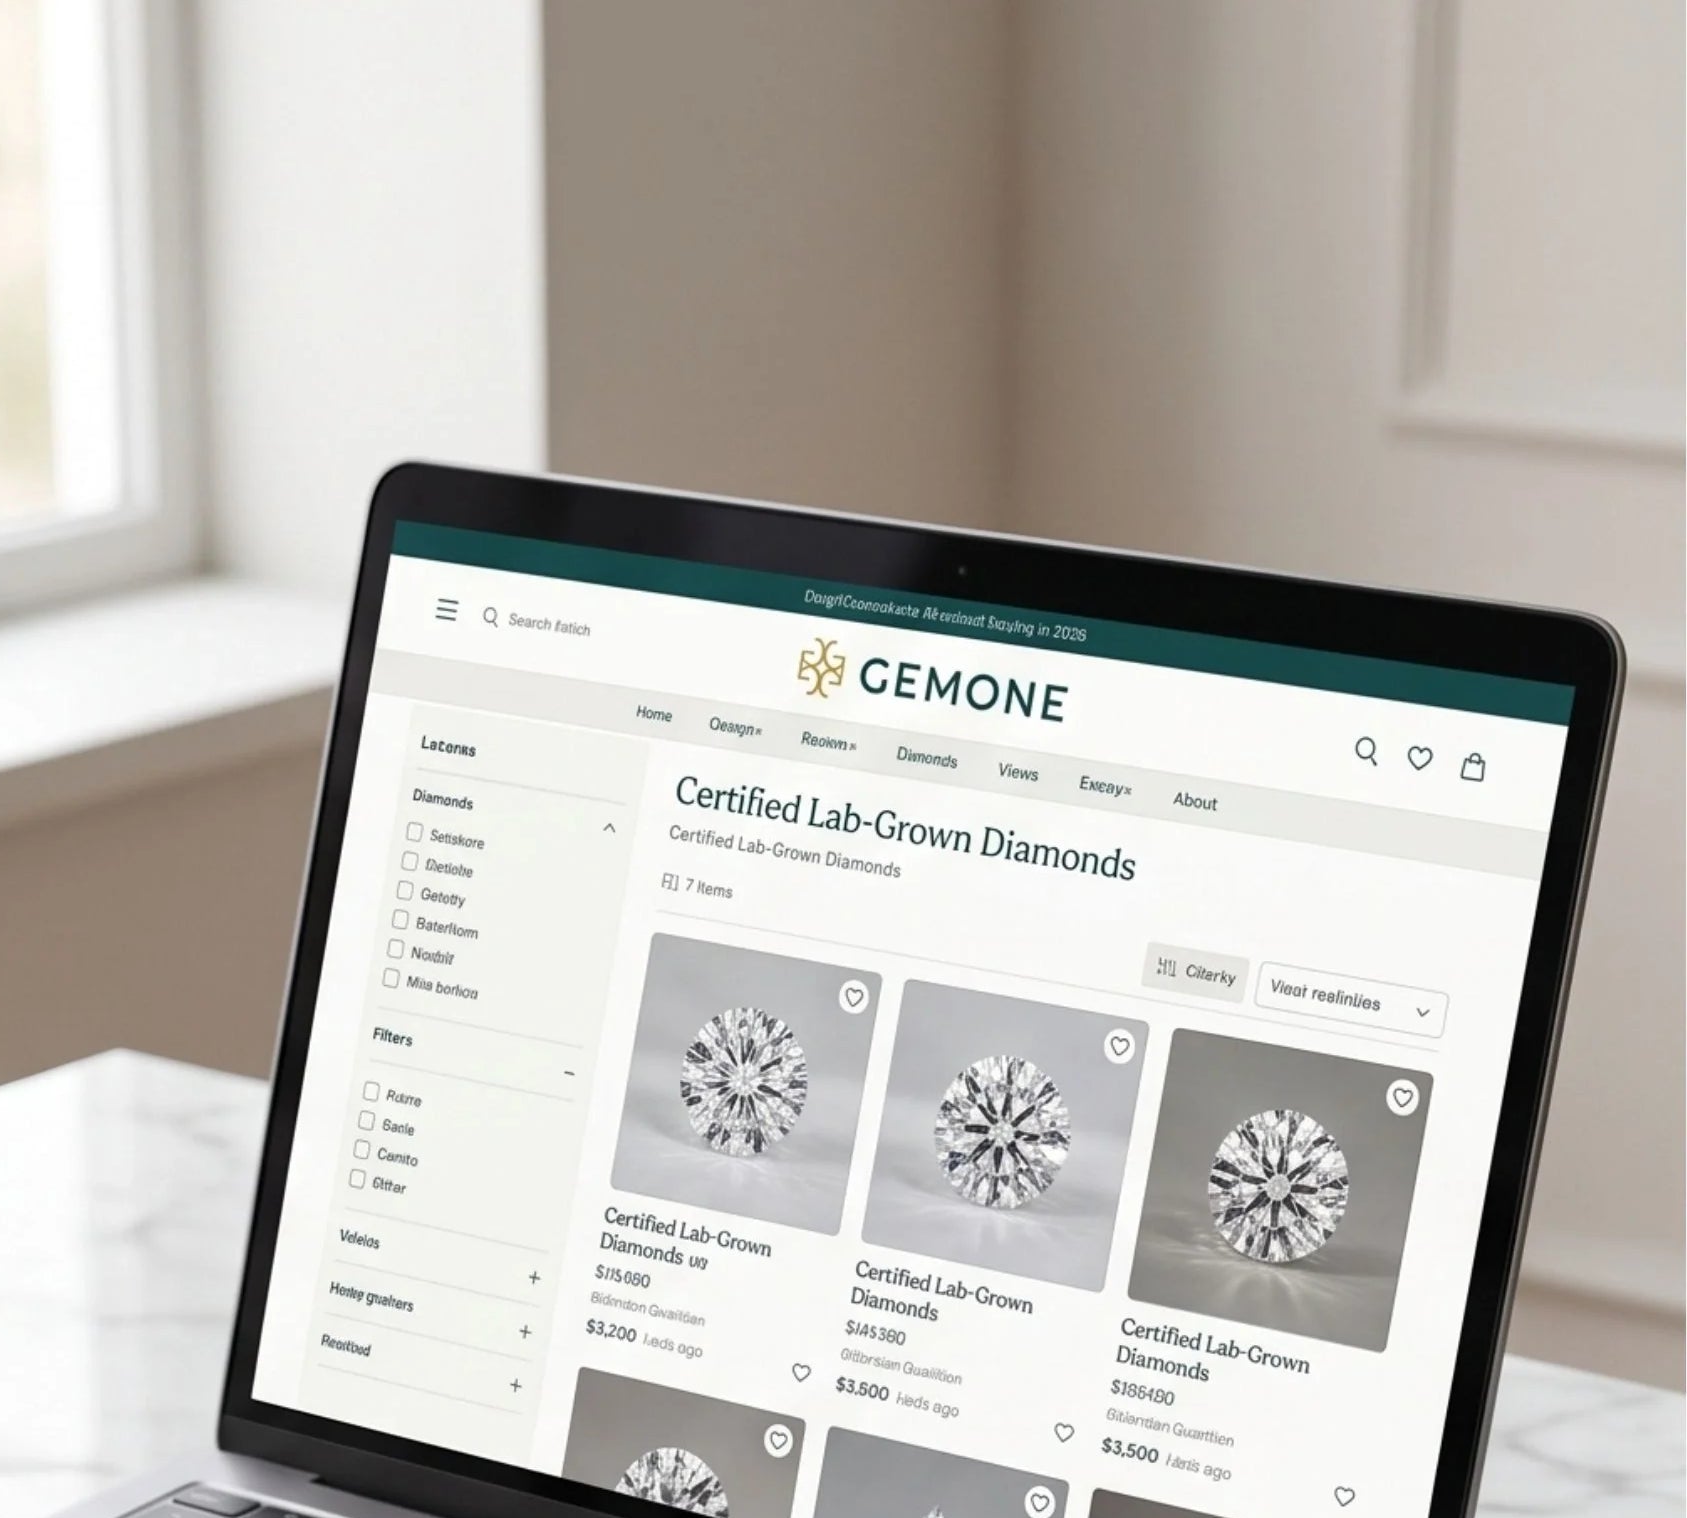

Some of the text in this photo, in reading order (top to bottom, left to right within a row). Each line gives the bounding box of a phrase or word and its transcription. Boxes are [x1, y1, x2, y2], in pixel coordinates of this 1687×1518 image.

[508, 612, 552, 631] Search
[859, 657, 1069, 722] GEMONE
[636, 705, 673, 722] Home
[998, 762, 1040, 782] Views
[413, 788, 474, 810] Diamonds
[1173, 792, 1218, 811] About
[676, 776, 1137, 881] Certified Lab-Grown Diamonds
[669, 824, 902, 878] Certified Lab-Grown Diamonds
[685, 878, 734, 900] 7 Items
[373, 1026, 414, 1047] Filters
[600, 1232, 684, 1265] Diamonds
[604, 1206, 773, 1258] Certified Lab-Grown
[855, 1259, 1034, 1314] Certified Lab-Grown
[850, 1286, 940, 1322] Diamonds
[1120, 1317, 1311, 1374] Certified Lab-Grown
[1116, 1345, 1210, 1382] Diamonds
